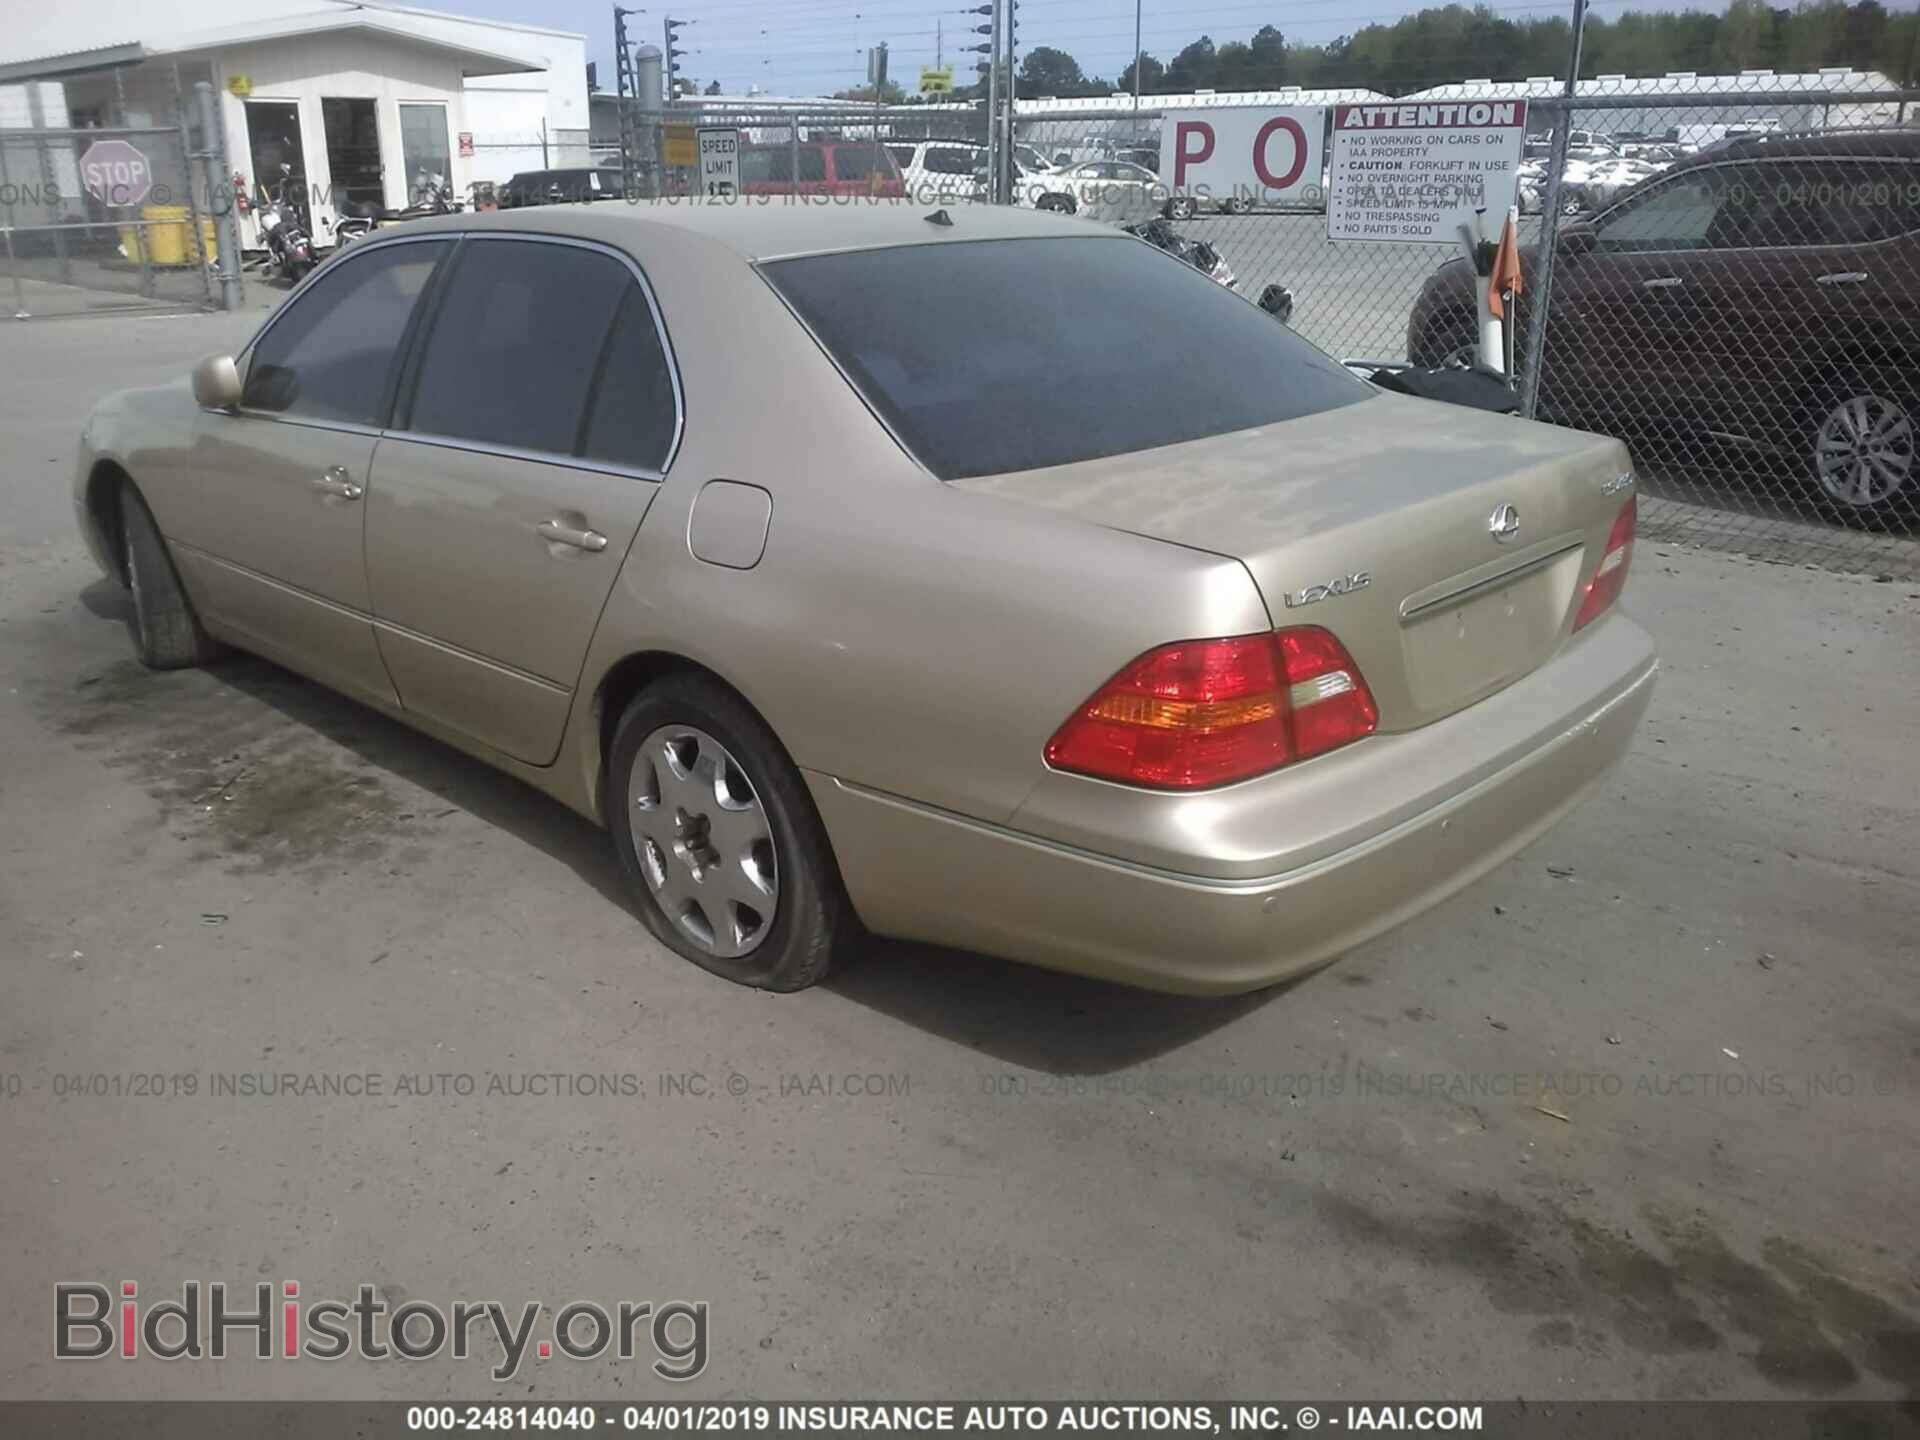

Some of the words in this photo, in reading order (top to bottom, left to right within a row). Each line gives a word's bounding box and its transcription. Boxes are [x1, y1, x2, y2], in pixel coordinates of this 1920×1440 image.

[1344, 103, 1516, 128] ATTENTION
[702, 139, 736, 153] SPEED
[1350, 136, 1366, 146] NO
[1369, 136, 1423, 146] WORKING
[1427, 135, 1444, 145] ON
[1448, 134, 1481, 144] CARS
[1486, 134, 1504, 144] ON
[1174, 121, 1216, 187] P
[1253, 116, 1309, 190] O
[1350, 147, 1367, 157] IAA
[1371, 147, 1430, 157] PROPERTY
[706, 160, 733, 174] LIMIT
[1348, 161, 1403, 170] CAUTION
[1410, 160, 1464, 170] FORKLIFT
[1469, 160, 1481, 170] IN
[1485, 161, 1510, 170] USE
[87, 161, 146, 186] STOP
[1347, 174, 1364, 184] NO
[1367, 173, 1431, 184] OVERNIGHT
[1434, 173, 1484, 184] PARKING
[1346, 186, 1376, 197] OPEN
[1381, 187, 1395, 196] TO
[1399, 186, 1450, 197] DEALERS
[1345, 199, 1384, 209] SPEED
[1386, 199, 1414, 209] LIMIT
[1417, 200, 1431, 209] 15
[1433, 199, 1458, 209] MPH
[1344, 211, 1361, 221] NO
[1364, 211, 1440, 223] TRESPASSING
[1344, 223, 1360, 233] NO
[1364, 223, 1397, 234] PARTS
[1401, 225, 1432, 235] SOLD
[1283, 569, 1371, 608] LEXUS
